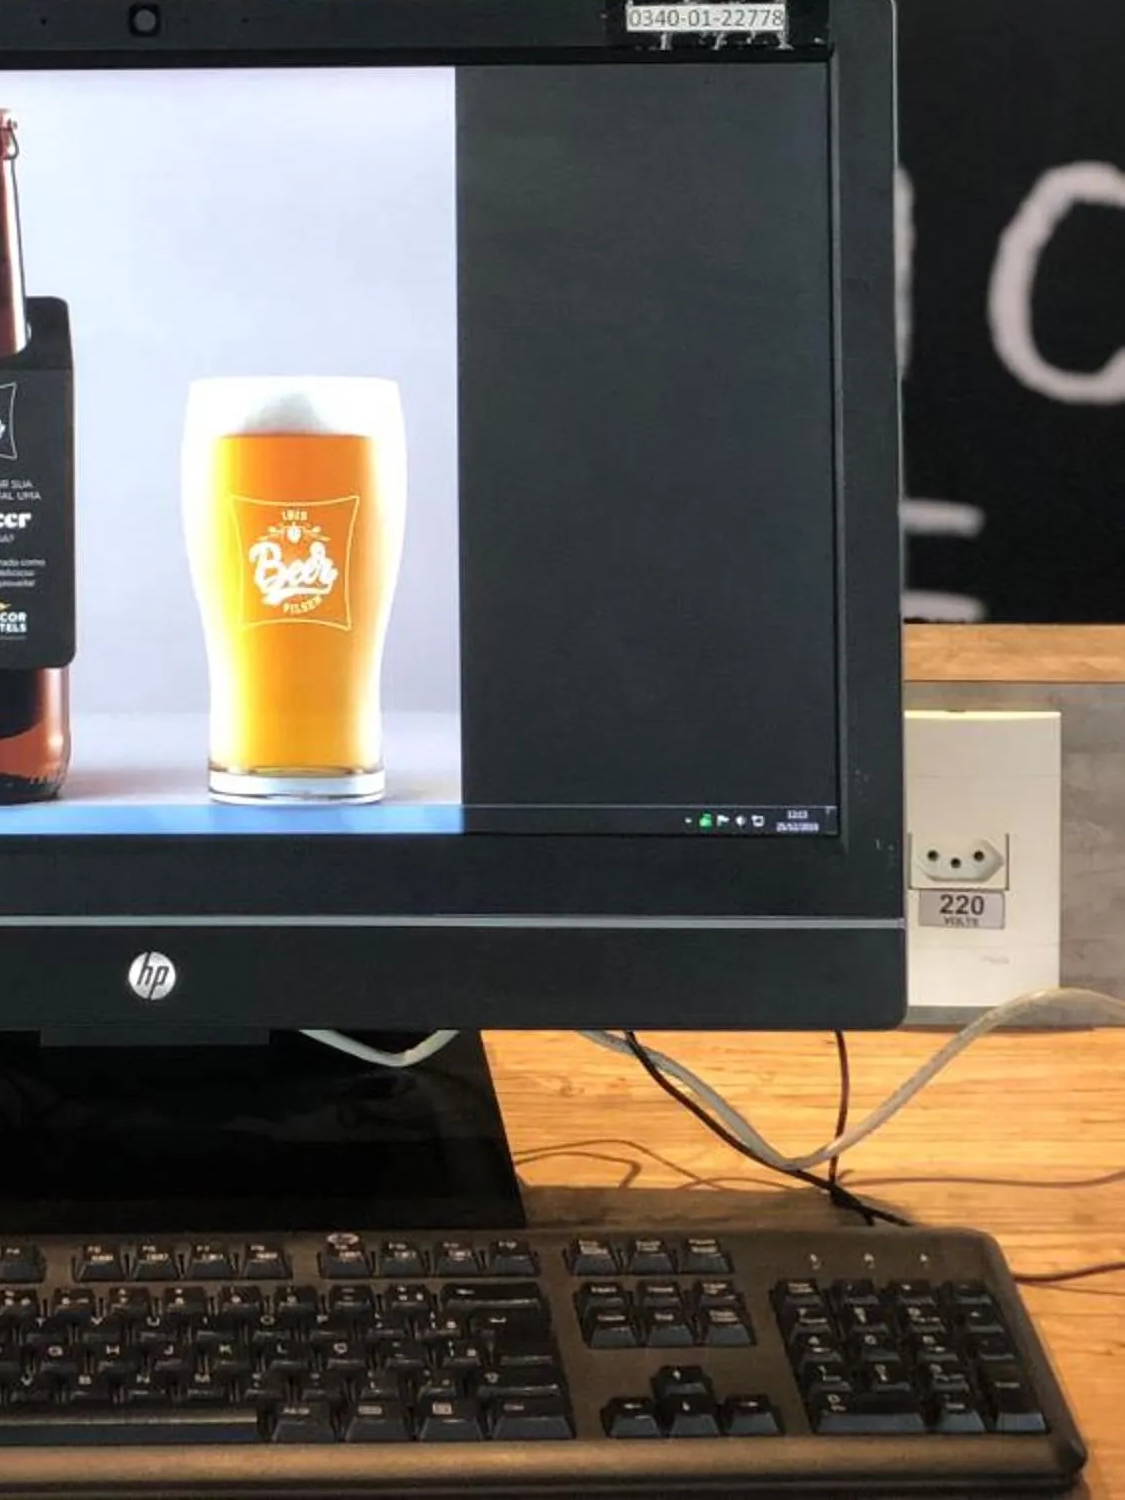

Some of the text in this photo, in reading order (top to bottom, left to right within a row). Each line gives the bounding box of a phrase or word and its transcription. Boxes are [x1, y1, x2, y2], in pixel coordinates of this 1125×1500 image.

[628, 7, 785, 28] 0340-01-22778
[11, 480, 33, 489] SUA
[939, 894, 985, 916] 220
[133, 950, 174, 1000] hp
